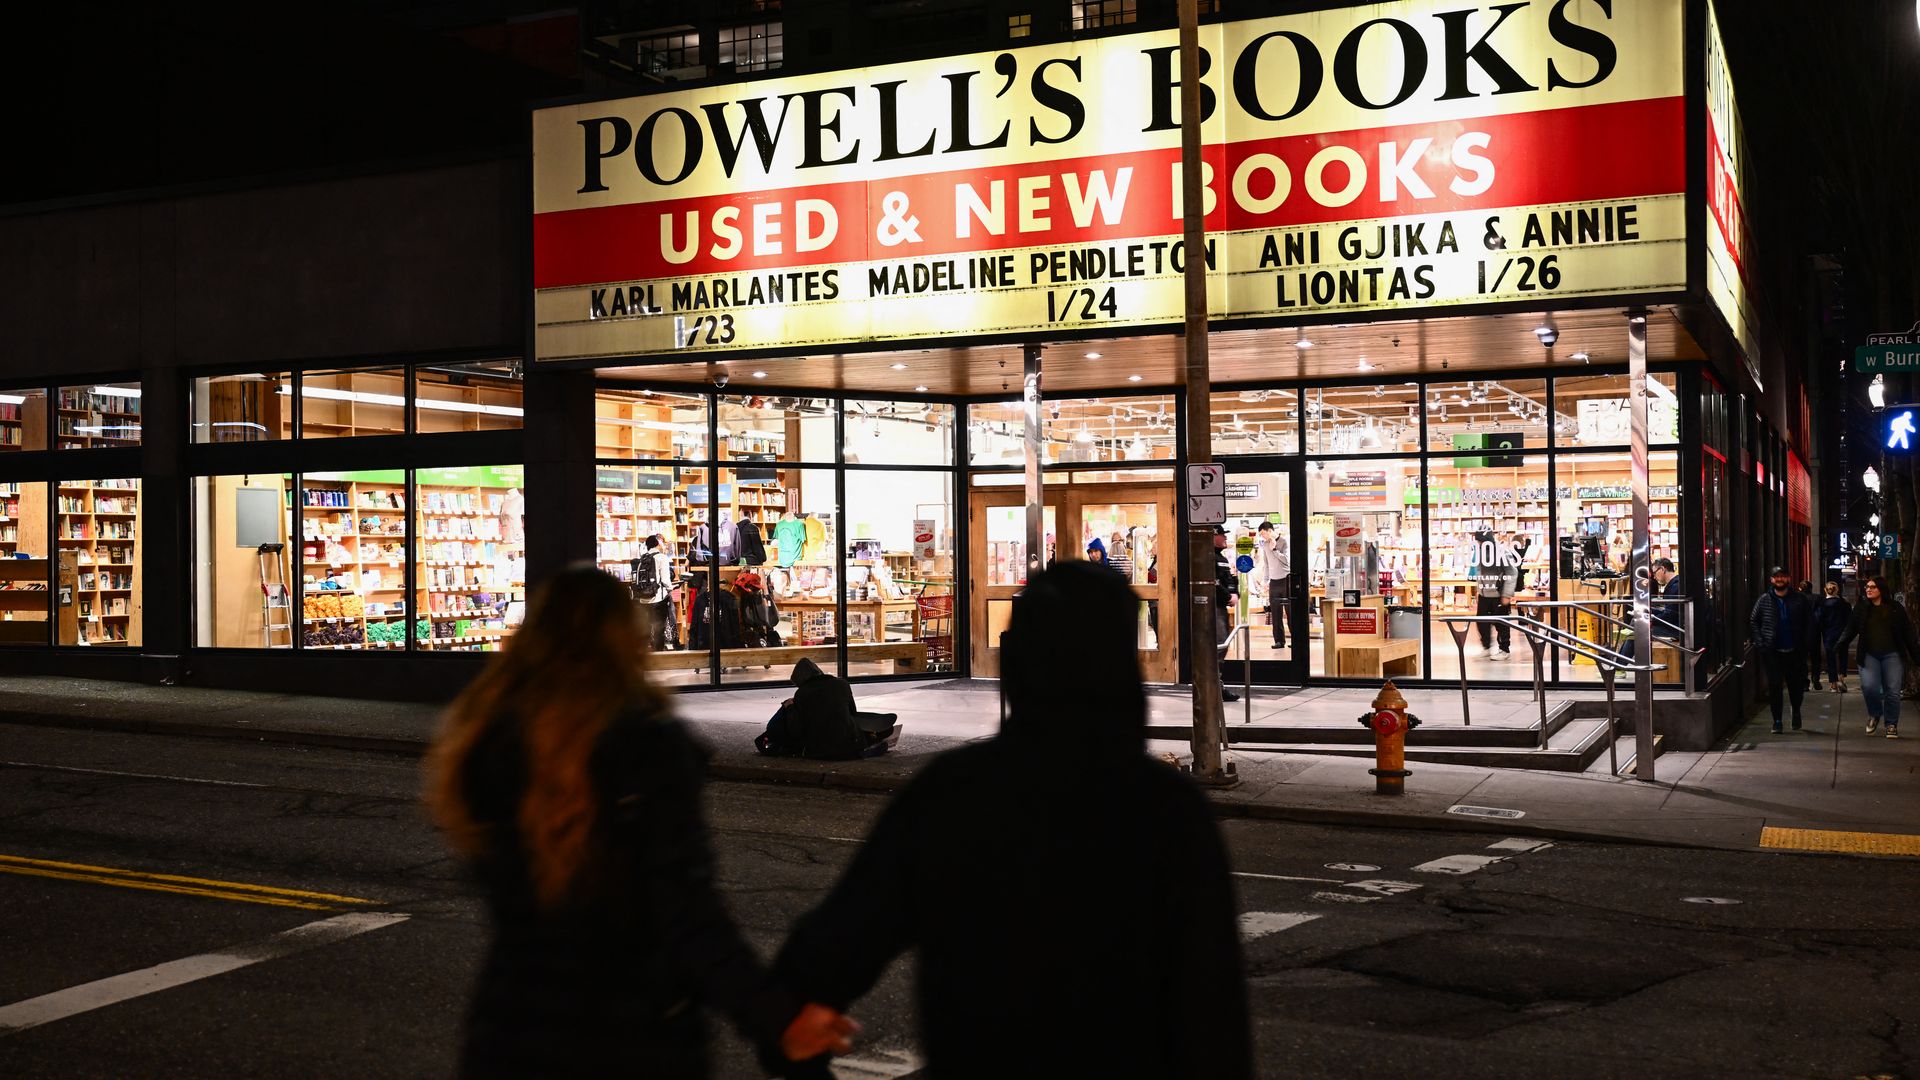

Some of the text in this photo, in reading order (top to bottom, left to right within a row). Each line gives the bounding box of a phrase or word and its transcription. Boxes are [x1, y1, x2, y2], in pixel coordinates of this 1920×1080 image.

[576, 52, 1087, 194] POWELL'S
[1140, 0, 1618, 133] BOOKS
[660, 131, 1497, 265] USED & NEW BOOKS
[1258, 205, 1641, 268] ANI GJIKA & ANNIE
[868, 238, 1217, 298] MADELINE PENDLETON
[1276, 254, 1561, 308] LIONTAS 1/26
[589, 269, 840, 319] KARL MARLANTES
[1047, 286, 1118, 325] 1/24
[674, 313, 736, 349] 1/23
[1869, 335, 1912, 345] PEARL
[1456, 540, 1524, 568] OOKS
[1885, 546, 1893, 555] 2
